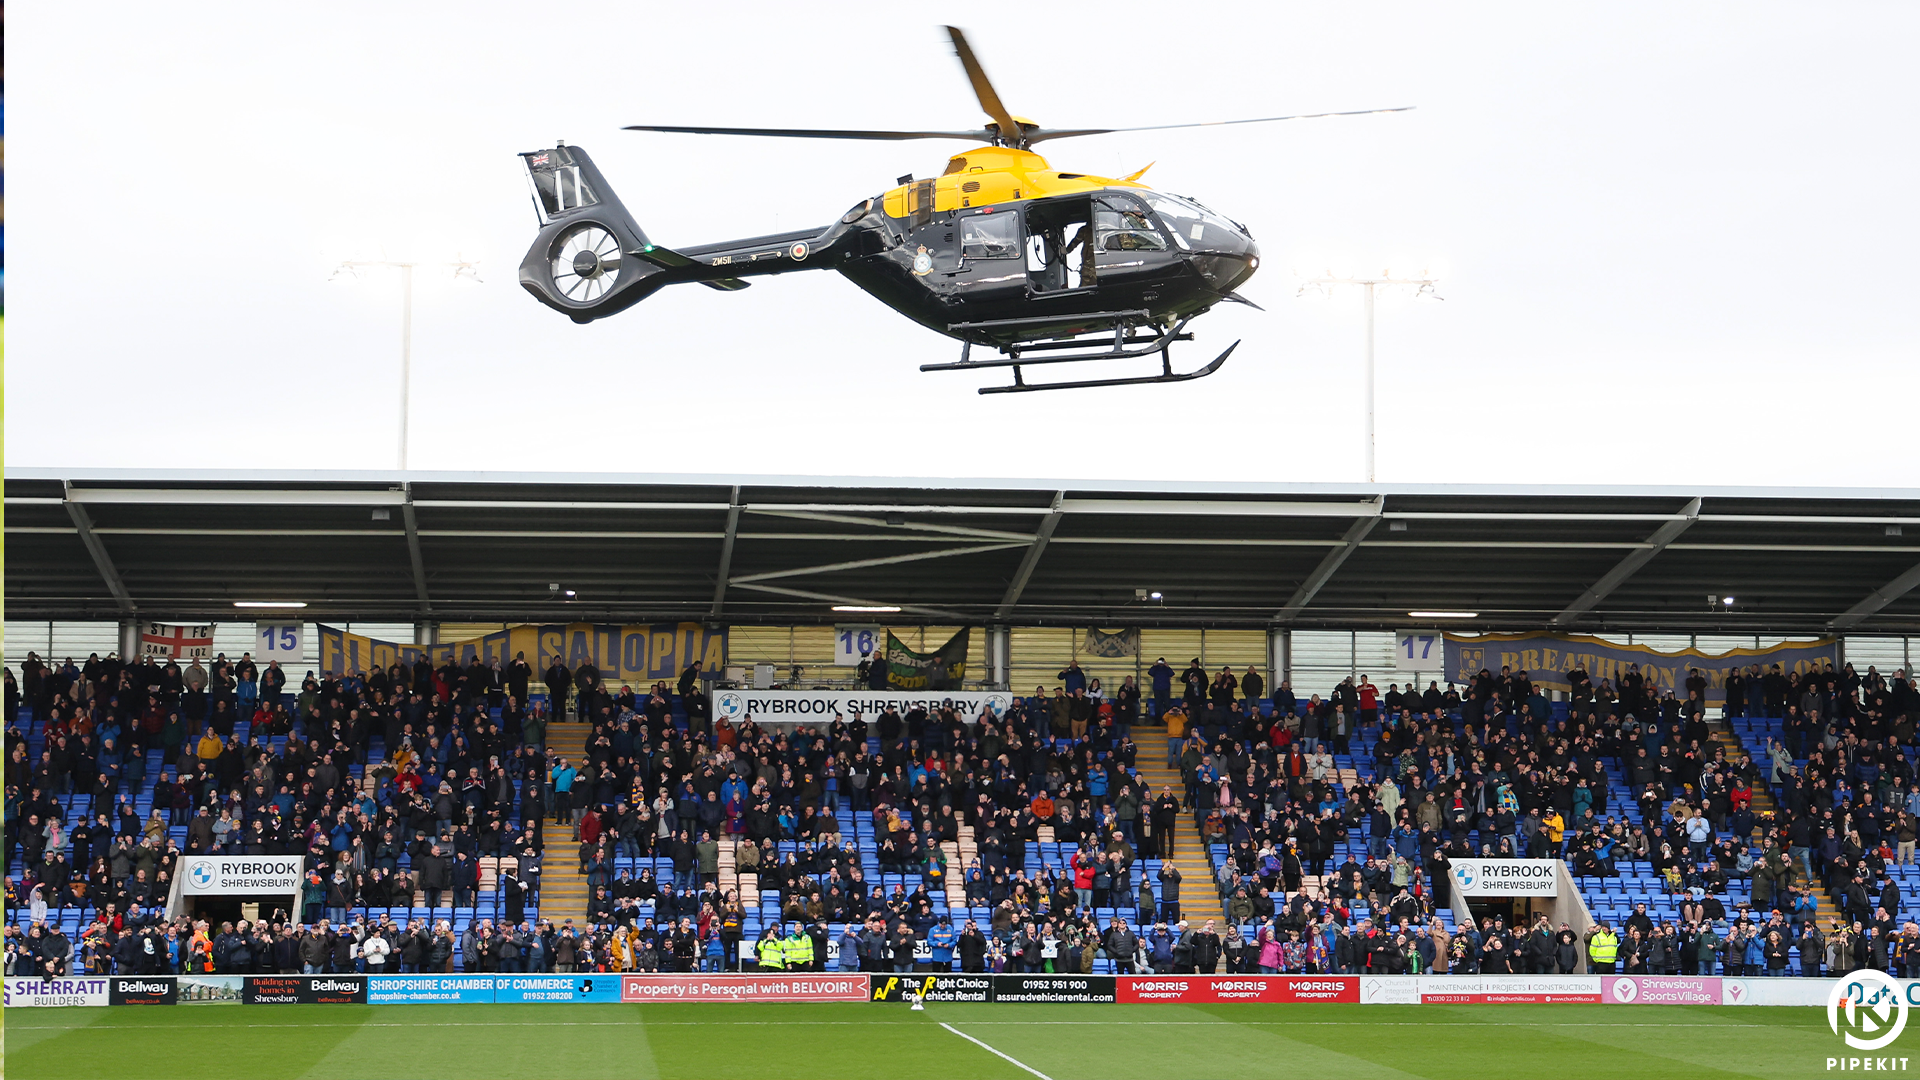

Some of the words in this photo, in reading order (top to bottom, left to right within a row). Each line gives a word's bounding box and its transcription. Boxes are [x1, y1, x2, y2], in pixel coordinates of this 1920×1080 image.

[192, 625, 208, 639] FC
[262, 625, 297, 651] 15
[840, 629, 874, 655] 16
[146, 644, 168, 656] SAM
[190, 647, 206, 658] LOZ
[541, 629, 723, 673] SALOPIA
[1402, 635, 1435, 660] 17
[747, 699, 839, 714] RYBROOK
[847, 699, 979, 715] SHREWSBRY
[221, 863, 297, 875] RYBROOK
[1482, 865, 1553, 877] RYBROOK
[221, 879, 297, 888] SHREWSBURY
[1482, 881, 1553, 890] SHREWSBURY
[15, 980, 106, 995] SHERRATT
[253, 978, 283, 987] Building
[311, 980, 360, 993] Bellway
[370, 979, 439, 990] SHROPSHIRE
[440, 979, 494, 990] CHAMBER
[496, 979, 511, 990] OF
[512, 979, 574, 990] COMMERCE
[902, 978, 920, 988] The
[956, 978, 989, 988] Choice
[1022, 980, 1050, 989] 01952
[1051, 980, 1067, 989] 951
[1069, 980, 1088, 989] 900
[1132, 981, 1189, 991] MORRIS
[1211, 981, 1267, 991] MORRIS
[1289, 981, 1346, 991] MORRIS
[1642, 979, 1703, 991] Shrewsbury
[118, 981, 169, 995] Bellway
[259, 986, 286, 994] homes
[629, 982, 686, 997] Property
[688, 983, 699, 994] is
[702, 982, 758, 995] Personal
[760, 982, 789, 994] with
[792, 981, 853, 994] BELVOIR!
[1384, 987, 1415, 995] Integrated
[1492, 984, 1526, 992] PROJECTS
[34, 996, 86, 1006] BUILDERS
[254, 994, 299, 1004] Shrewsbury
[370, 991, 461, 1001] shropshire-chamber.co.uk
[523, 992, 545, 1000] 01952
[546, 992, 573, 1000] 208200
[902, 991, 916, 1000] for
[955, 991, 986, 1001] Rental
[996, 992, 1114, 1002] assuredvehiclerental.com
[1642, 991, 1677, 1002] Sports
[1677, 991, 1712, 1003] Village
